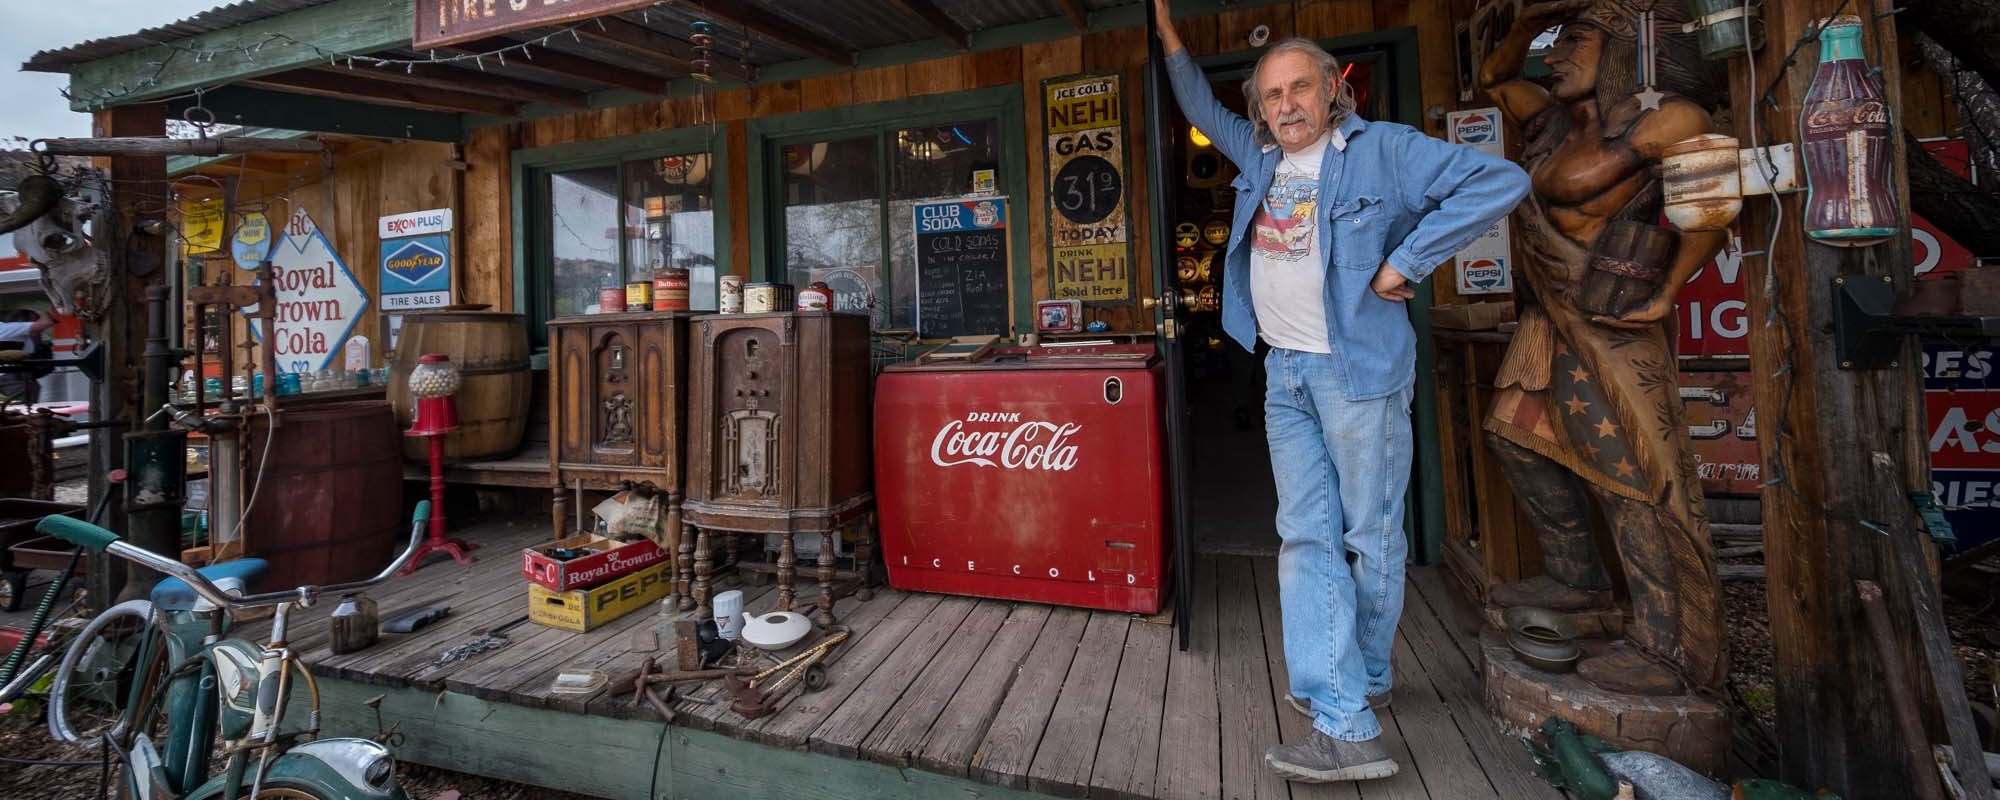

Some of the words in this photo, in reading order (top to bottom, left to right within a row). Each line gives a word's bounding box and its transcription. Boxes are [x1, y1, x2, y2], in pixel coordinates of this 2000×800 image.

[1056, 88, 1076, 100] ICE
[1078, 83, 1109, 95] COLD
[1050, 98, 1118, 128] NEHI
[1457, 124, 1492, 135] PEPSI
[1056, 132, 1114, 156] GAS
[922, 204, 960, 219] CLUB
[290, 214, 311, 237] RC
[387, 219, 416, 234] EXXON
[417, 215, 442, 228] PLUS
[922, 217, 962, 231] SODA
[1058, 226, 1119, 242] TODAY
[1060, 249, 1093, 258] DRINK
[388, 254, 441, 271] GOODYEAR
[1057, 257, 1126, 283] NEHI
[273, 261, 336, 296] Royal
[1466, 269, 1501, 279] PEPSI
[1062, 286, 1088, 297] Sold
[1092, 285, 1123, 296] Here
[390, 297, 410, 306] TIRE
[414, 295, 441, 304] SALES
[273, 299, 343, 323] rown
[274, 327, 329, 355] Cola
[967, 412, 1021, 423] DRINK
[931, 419, 1083, 472] Coca-Cola
[568, 564, 609, 585] Royal
